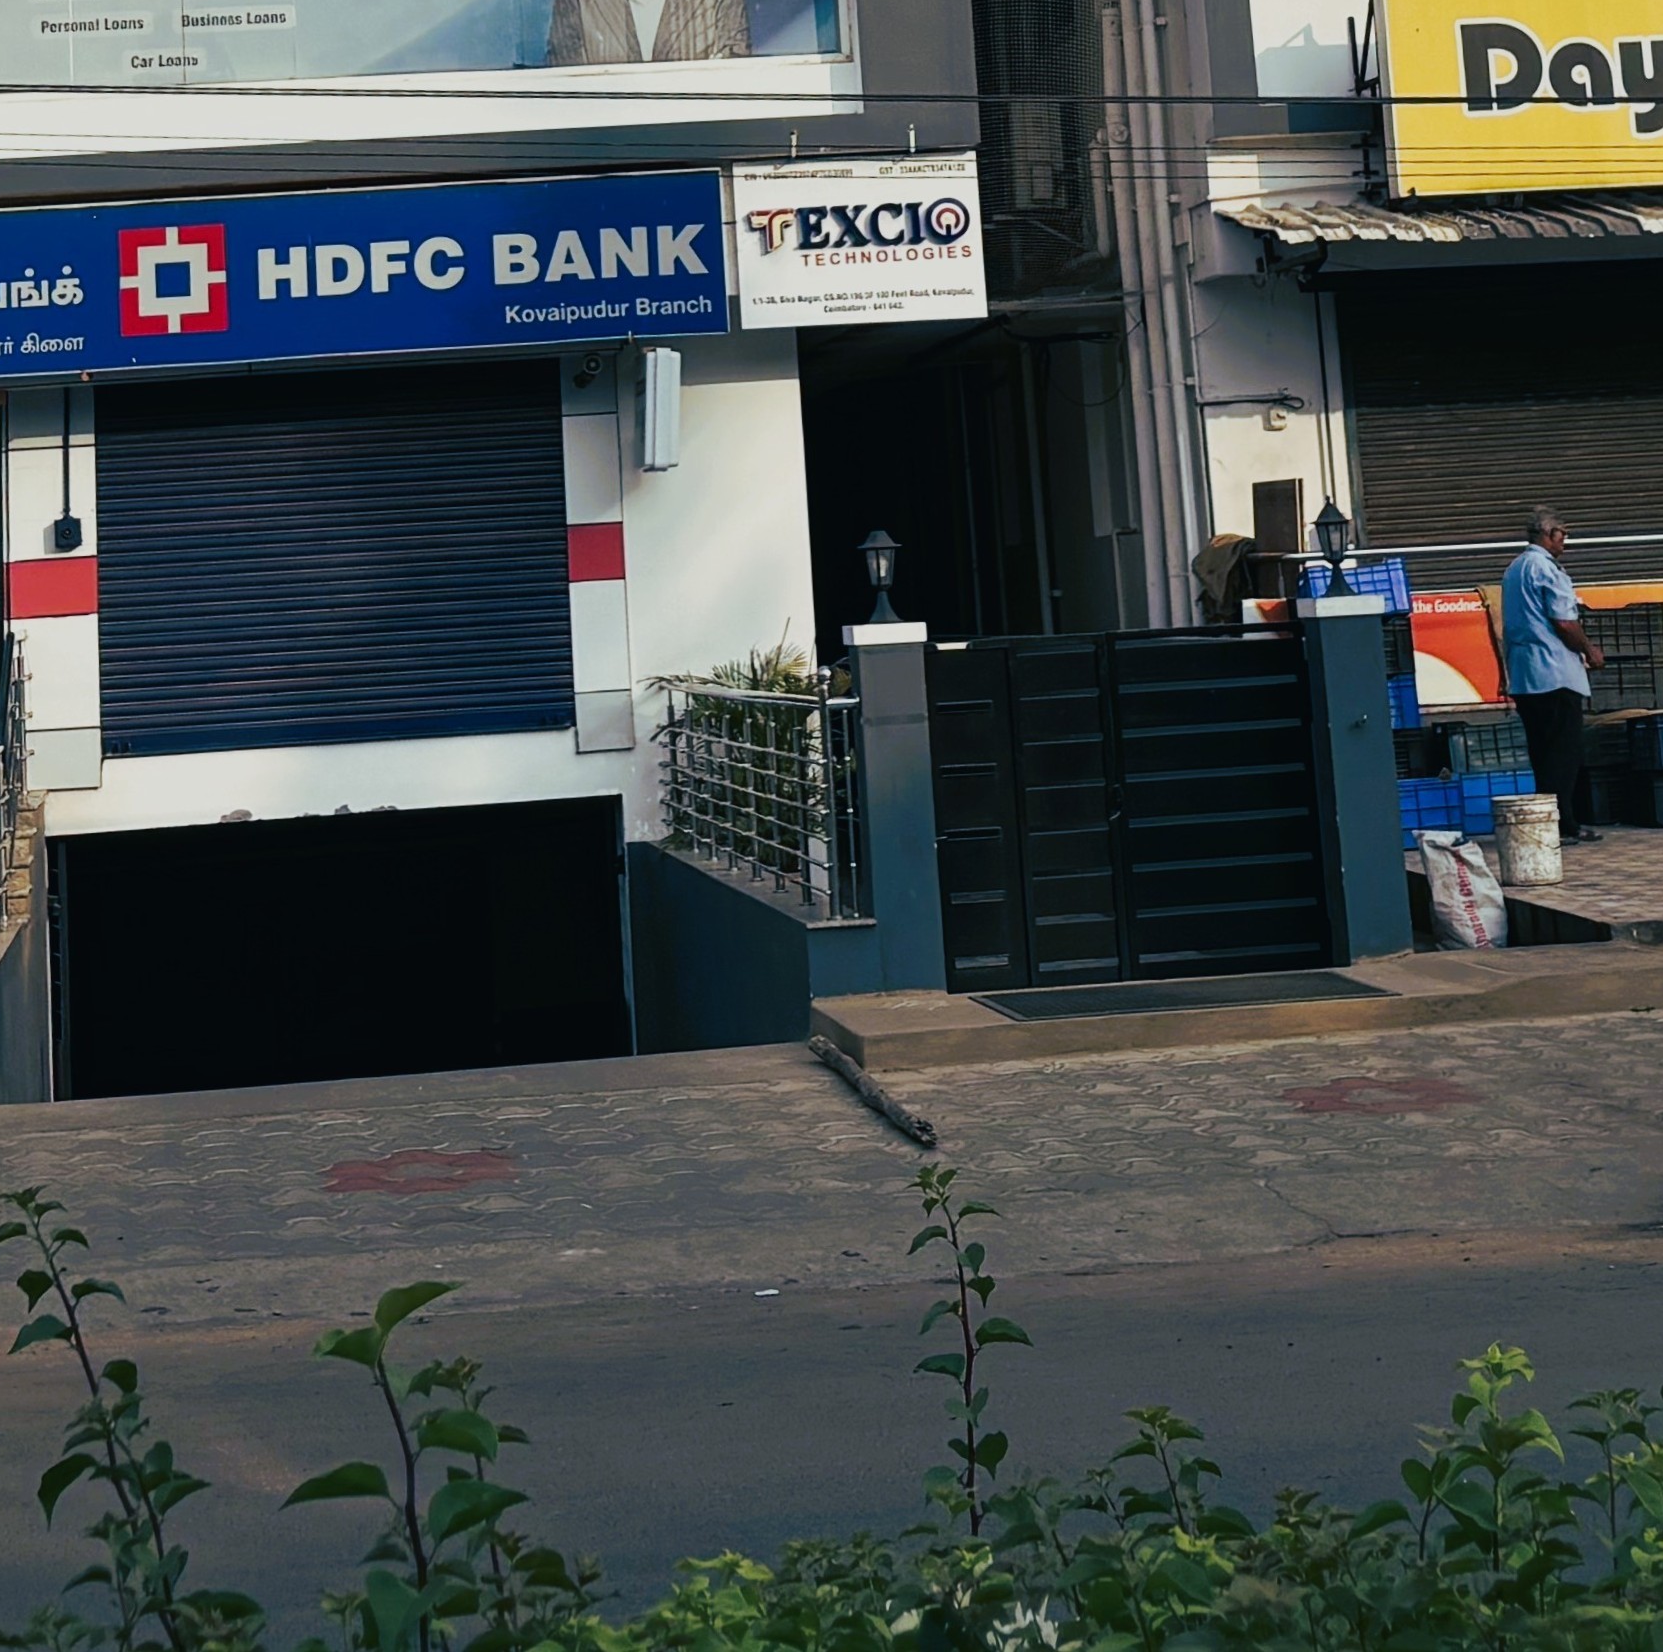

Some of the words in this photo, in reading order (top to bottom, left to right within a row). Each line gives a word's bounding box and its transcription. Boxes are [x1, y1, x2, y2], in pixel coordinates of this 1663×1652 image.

[40, 17, 101, 35] Personal
[104, 16, 145, 32] Loans
[181, 11, 243, 28] Business
[245, 10, 287, 25] Loans
[130, 54, 155, 69] Car
[158, 52, 199, 68] Loans
[256, 234, 467, 301] HDFC
[491, 222, 711, 286] BANK
[800, 245, 973, 267] TECHNOLOGIES
[504, 298, 631, 327] Kovaipudur
[635, 293, 713, 318] Branch
[18, 331, 86, 357] கிளை
